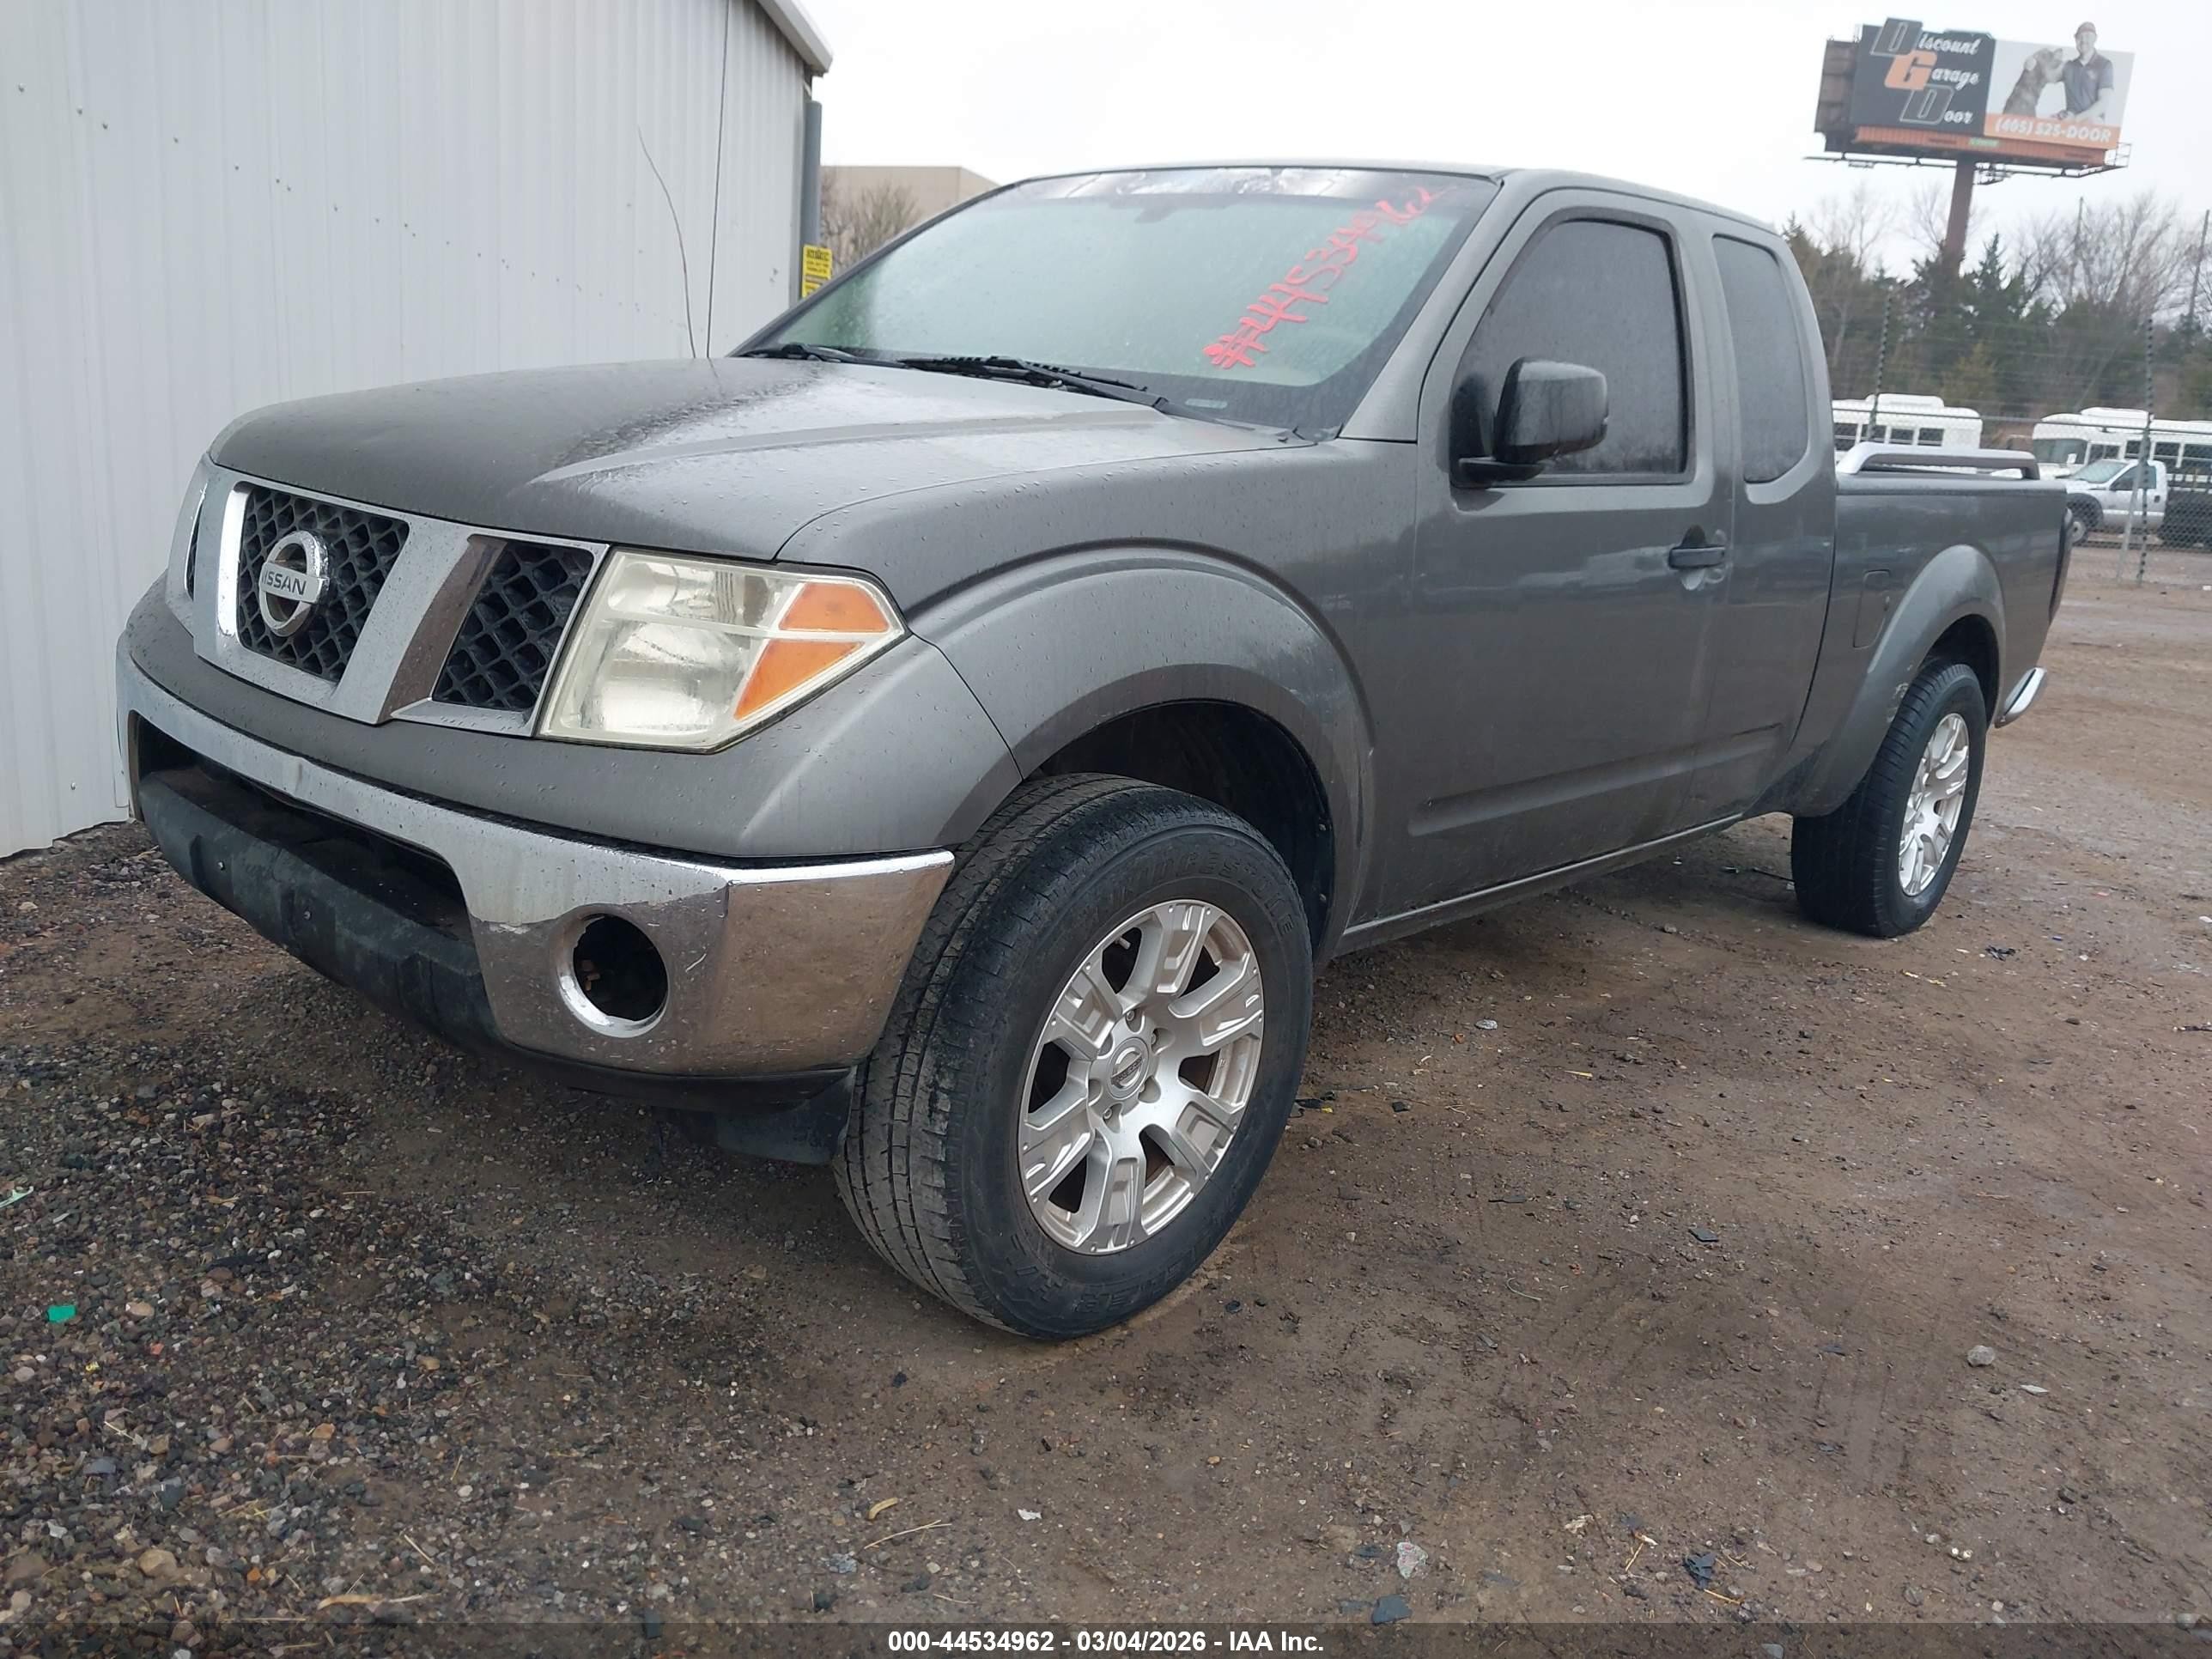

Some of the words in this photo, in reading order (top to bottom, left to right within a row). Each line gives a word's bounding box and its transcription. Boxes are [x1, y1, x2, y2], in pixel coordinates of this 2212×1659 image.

[1869, 17, 1982, 56] Discount
[1884, 49, 1980, 91] Garage
[1899, 83, 1973, 125] Door
[2035, 123, 2112, 143] 525-DOOR
